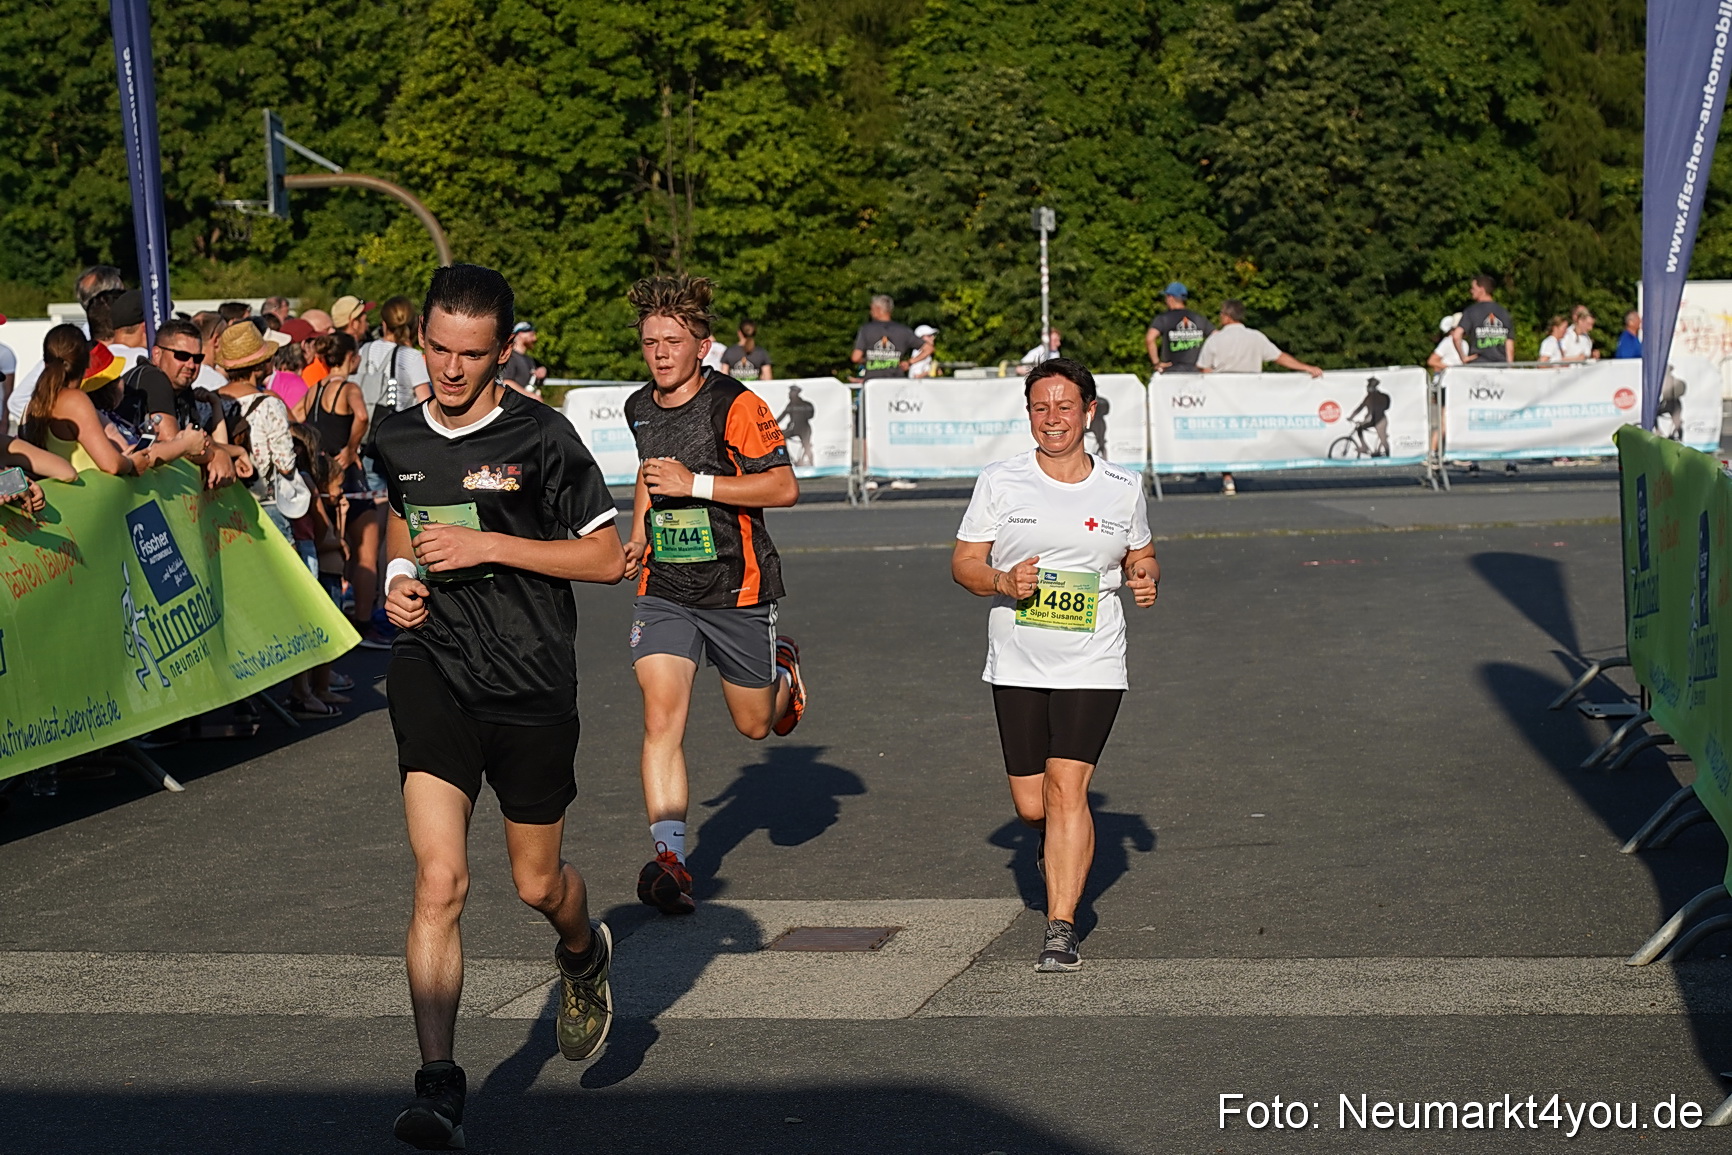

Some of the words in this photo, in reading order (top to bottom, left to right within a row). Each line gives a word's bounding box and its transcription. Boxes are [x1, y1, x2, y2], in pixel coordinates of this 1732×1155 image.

[1665, 0, 1732, 273] www.fischer-automobil
[398, 472, 418, 482] CRAFT
[1104, 469, 1129, 483] CRAFT
[1007, 515, 1038, 525] Susanne
[138, 531, 169, 558] Fischer
[655, 532, 663, 552] RUN
[661, 527, 702, 546] 1744
[701, 529, 713, 554] 2022
[1034, 588, 1086, 612] 1488
[1085, 597, 1095, 624] 2022
[1029, 608, 1050, 619] Sippl
[1051, 611, 1083, 621] Susanne
[169, 637, 211, 679] neumarkt
